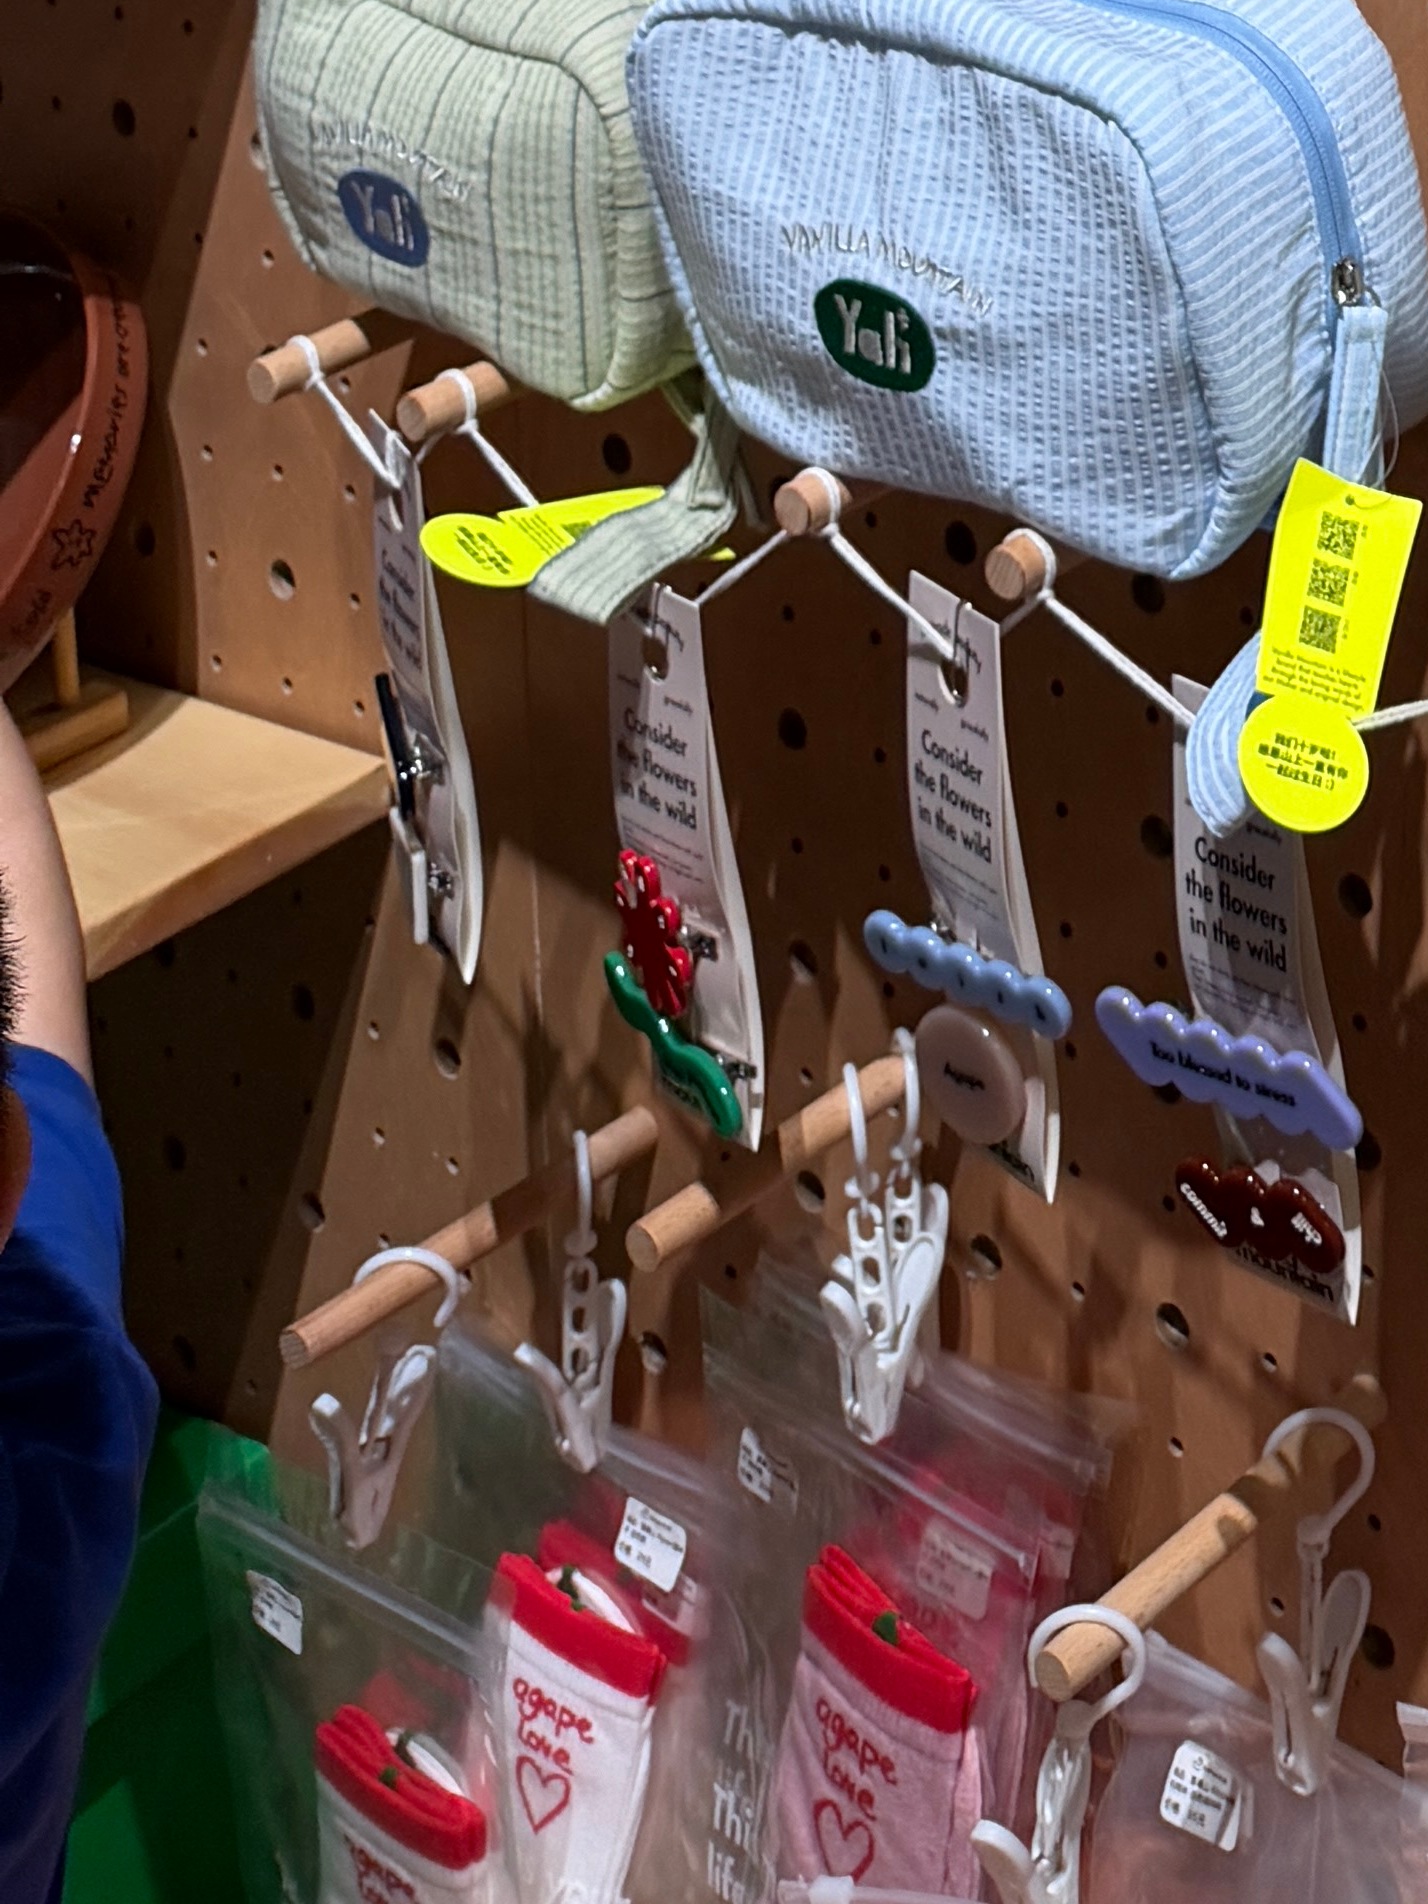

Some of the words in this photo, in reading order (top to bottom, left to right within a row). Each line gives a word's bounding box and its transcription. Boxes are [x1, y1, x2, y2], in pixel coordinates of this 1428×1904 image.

[780, 222, 871, 259] VANILLA
[832, 292, 912, 376] Yah
[624, 706, 688, 758] Consider
[921, 729, 983, 786] Consider
[641, 749, 698, 798] flowers
[914, 762, 936, 793] the
[940, 782, 992, 828] flowers
[638, 781, 662, 811] the
[664, 800, 698, 831] wild
[917, 796, 932, 824] in
[935, 812, 958, 843] the
[961, 833, 992, 864] wild
[1195, 836, 1276, 891] Consider
[1185, 868, 1214, 903] the
[1219, 880, 1288, 935] flowers
[1189, 907, 1207, 938] in
[1213, 918, 1241, 952] the
[1246, 939, 1287, 973] wild
[1151, 1041, 1175, 1066] Too
[1236, 1074, 1251, 1092] to
[512, 1677, 595, 1745] agape
[815, 1698, 899, 1787] agape
[517, 1713, 574, 1777] love
